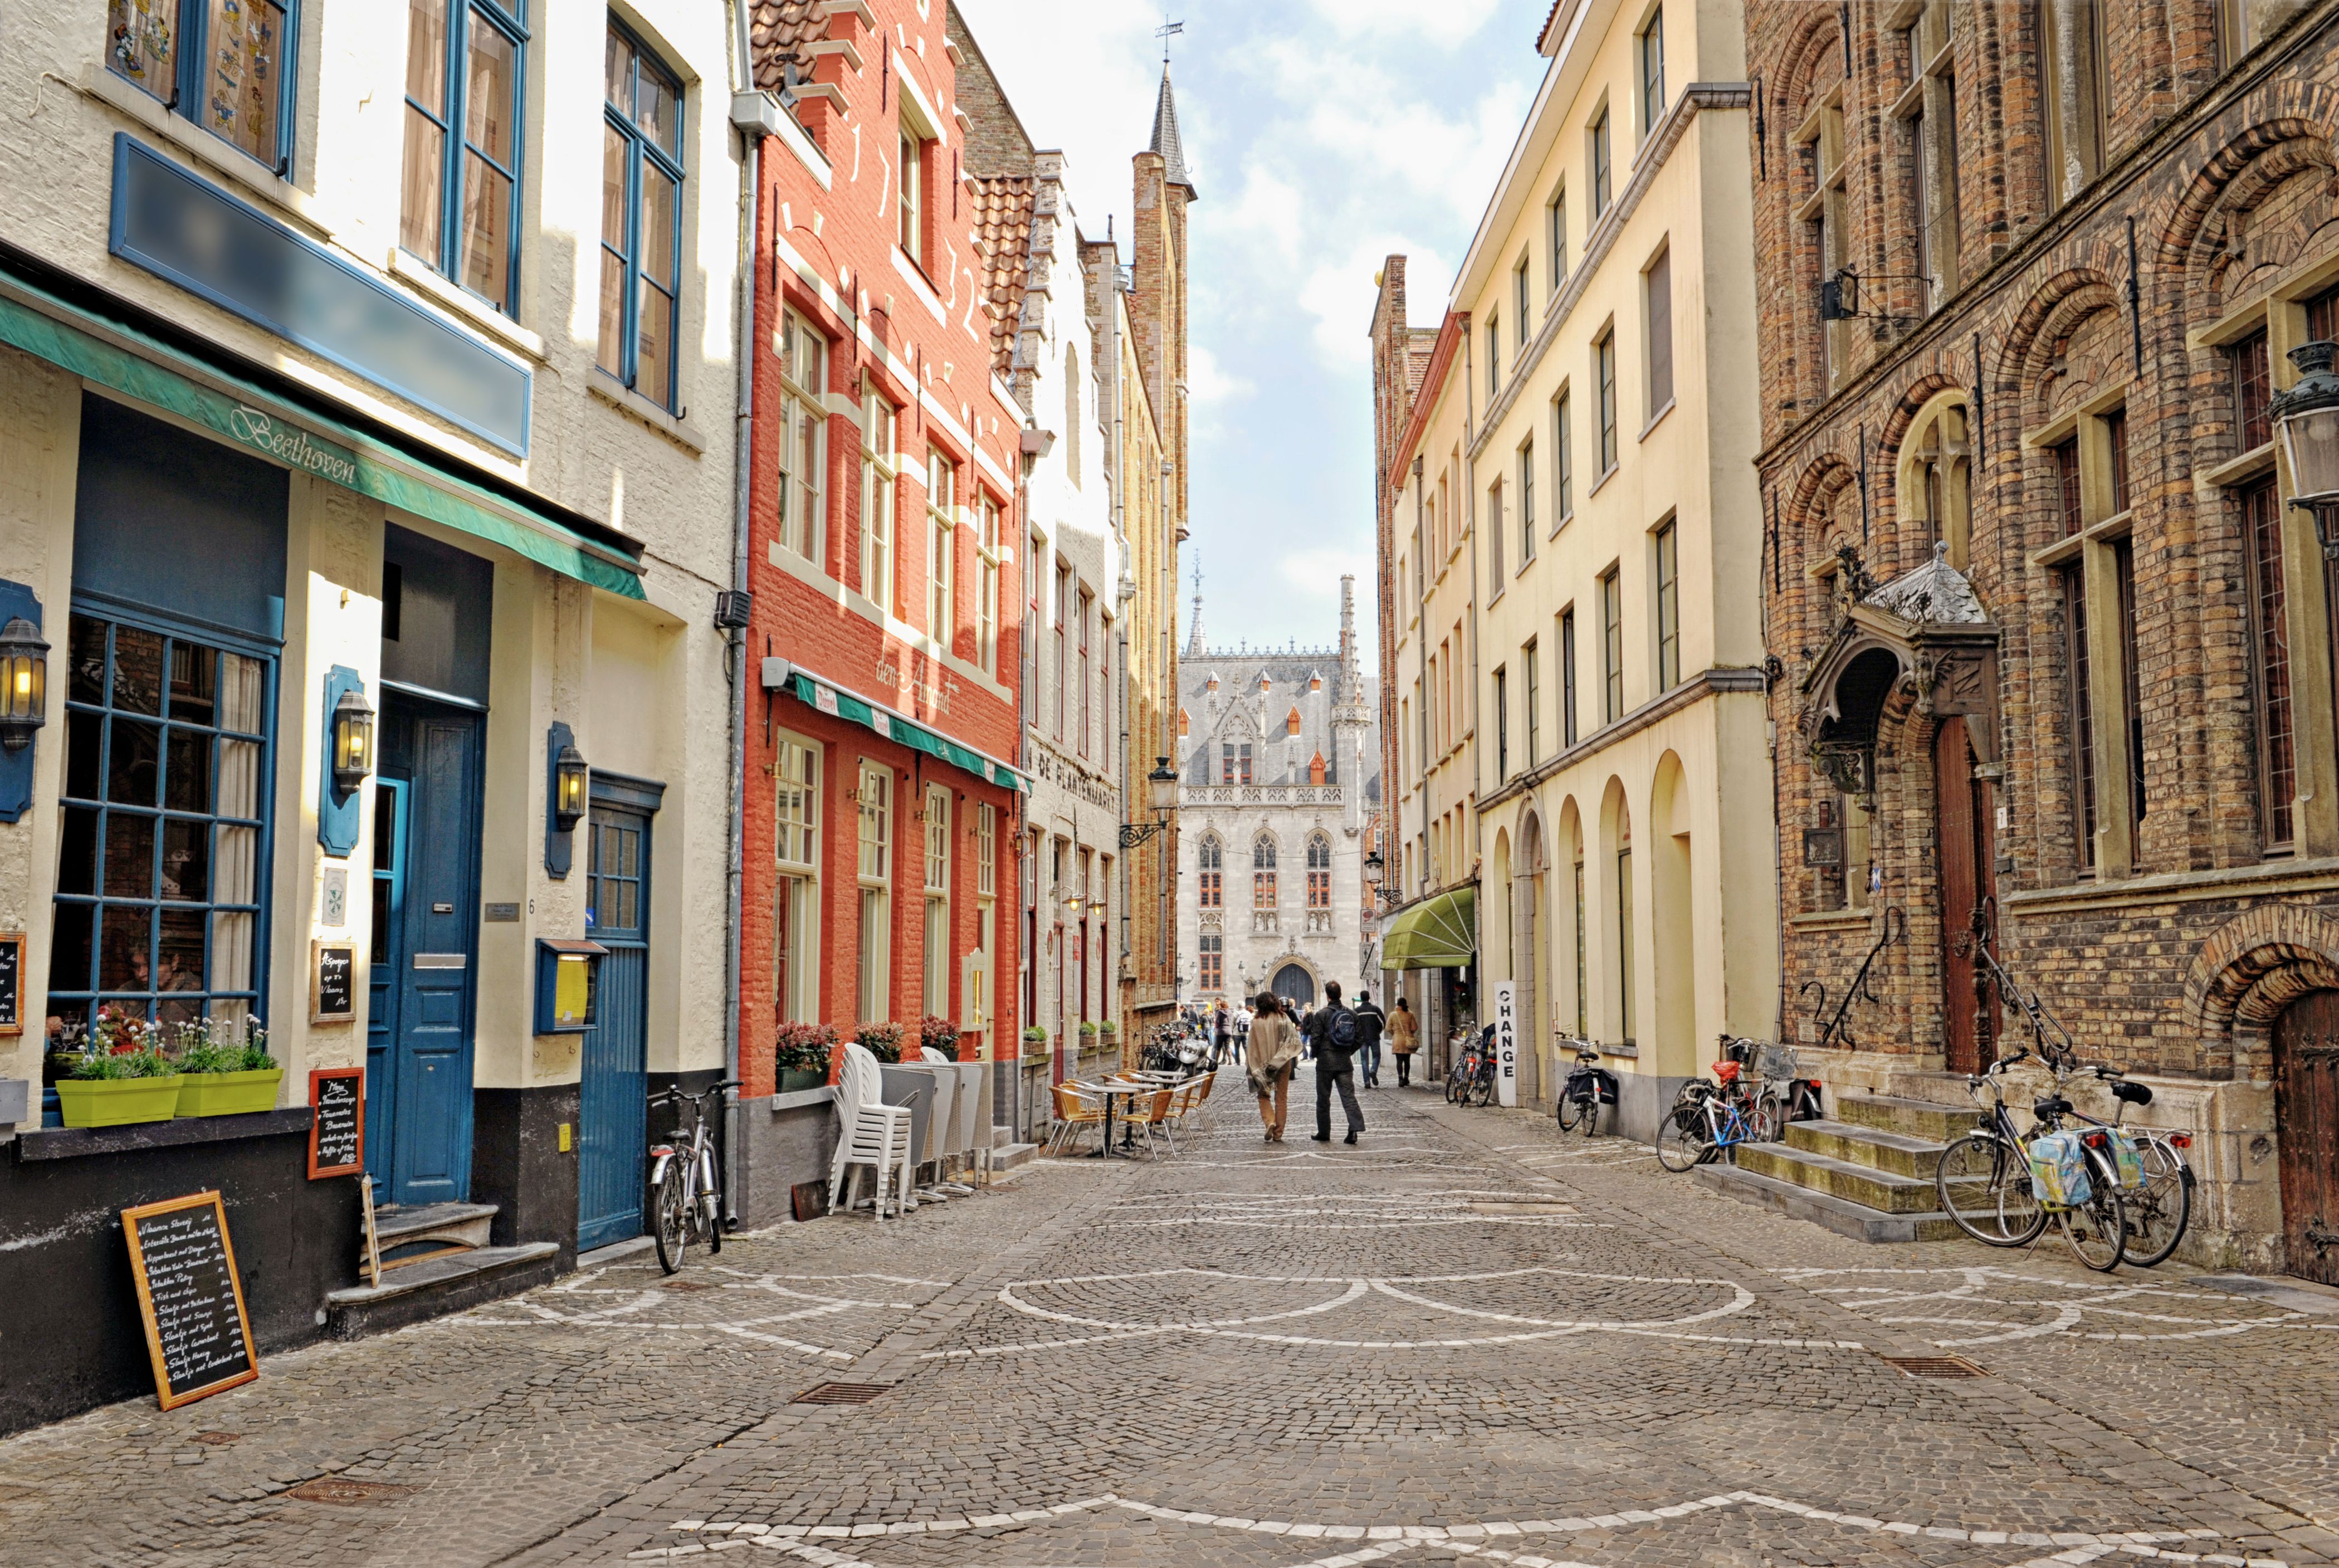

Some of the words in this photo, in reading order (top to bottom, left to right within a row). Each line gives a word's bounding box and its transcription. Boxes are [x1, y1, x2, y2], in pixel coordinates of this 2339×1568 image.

[229, 403, 356, 485] Beethoven
[876, 636, 896, 688] den
[817, 690, 835, 710] Duvel
[1039, 753, 1050, 781] DE
[1057, 764, 1114, 814] PLANTENMARKT
[529, 898, 535, 914] 6
[321, 984, 344, 994] Vlaams
[1499, 990, 1513, 1077] CHANGE
[328, 1082, 345, 1092] Menu
[155, 1291, 169, 1301] Fish
[159, 1304, 179, 1316] Slaatje
[160, 1317, 180, 1330] Slaatje
[164, 1328, 187, 1342] Slaatje
[165, 1342, 188, 1356] Slaatje
[169, 1355, 191, 1369] Slaatje
[172, 1367, 194, 1381] Slaatje
